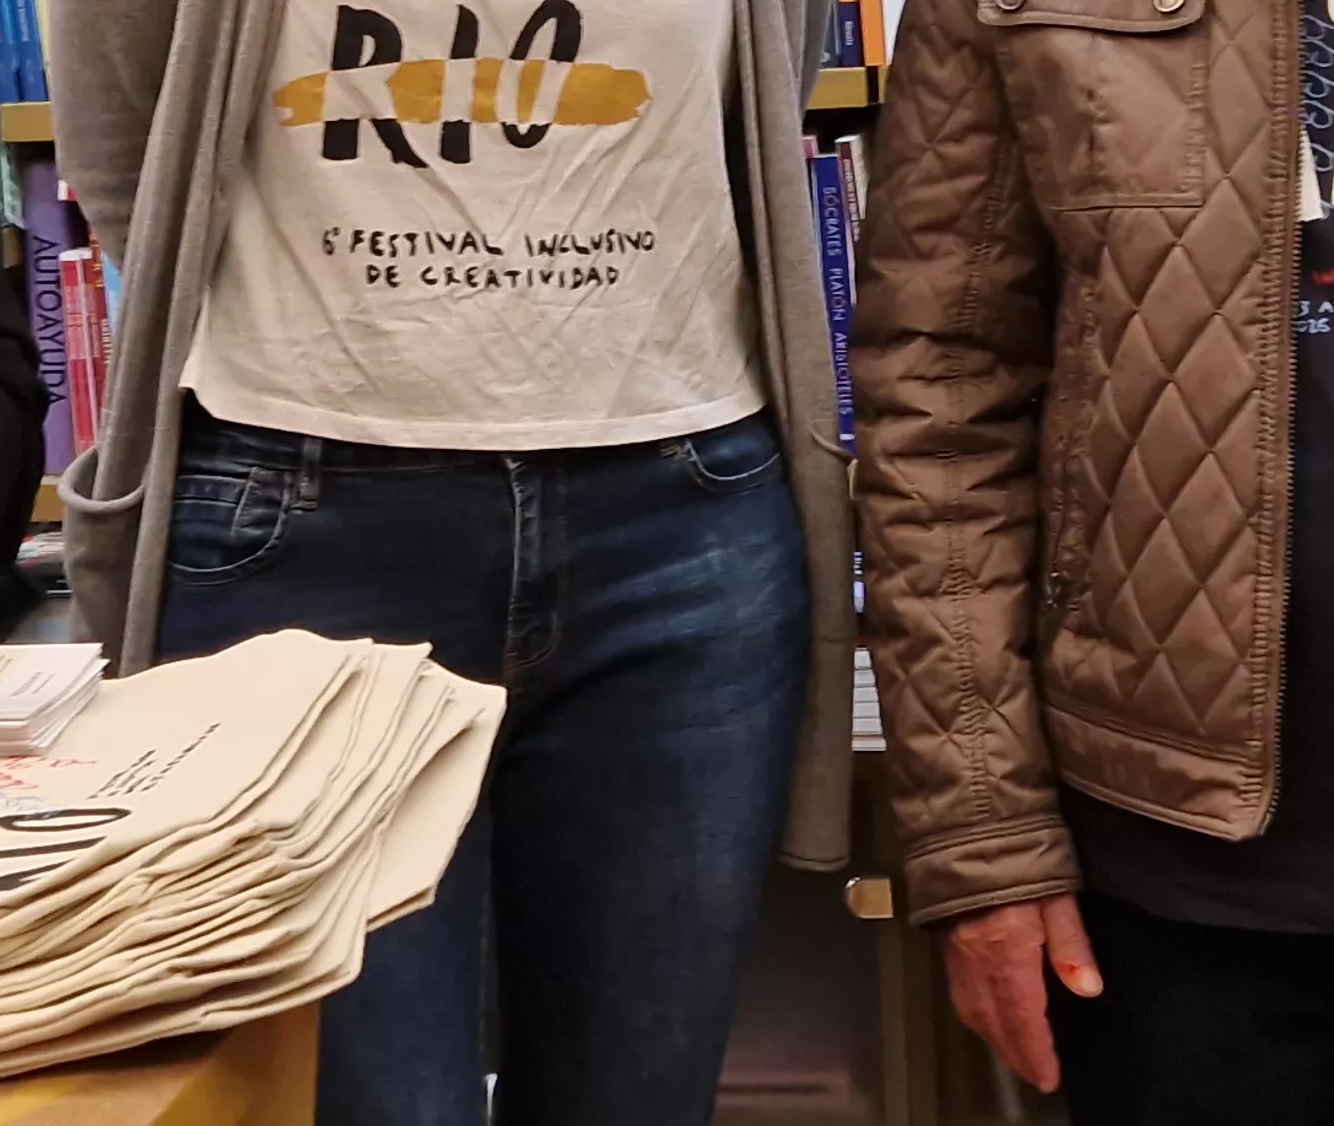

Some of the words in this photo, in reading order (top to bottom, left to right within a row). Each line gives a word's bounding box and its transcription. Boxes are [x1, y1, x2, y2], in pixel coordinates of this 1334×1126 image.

[349, 228, 506, 258] FESTIVAL
[524, 227, 657, 257] INCLUSIVO
[366, 262, 402, 289] DE
[419, 263, 620, 290] CREATIVIDAD
[30, 235, 68, 406] AUTOAYUDA
